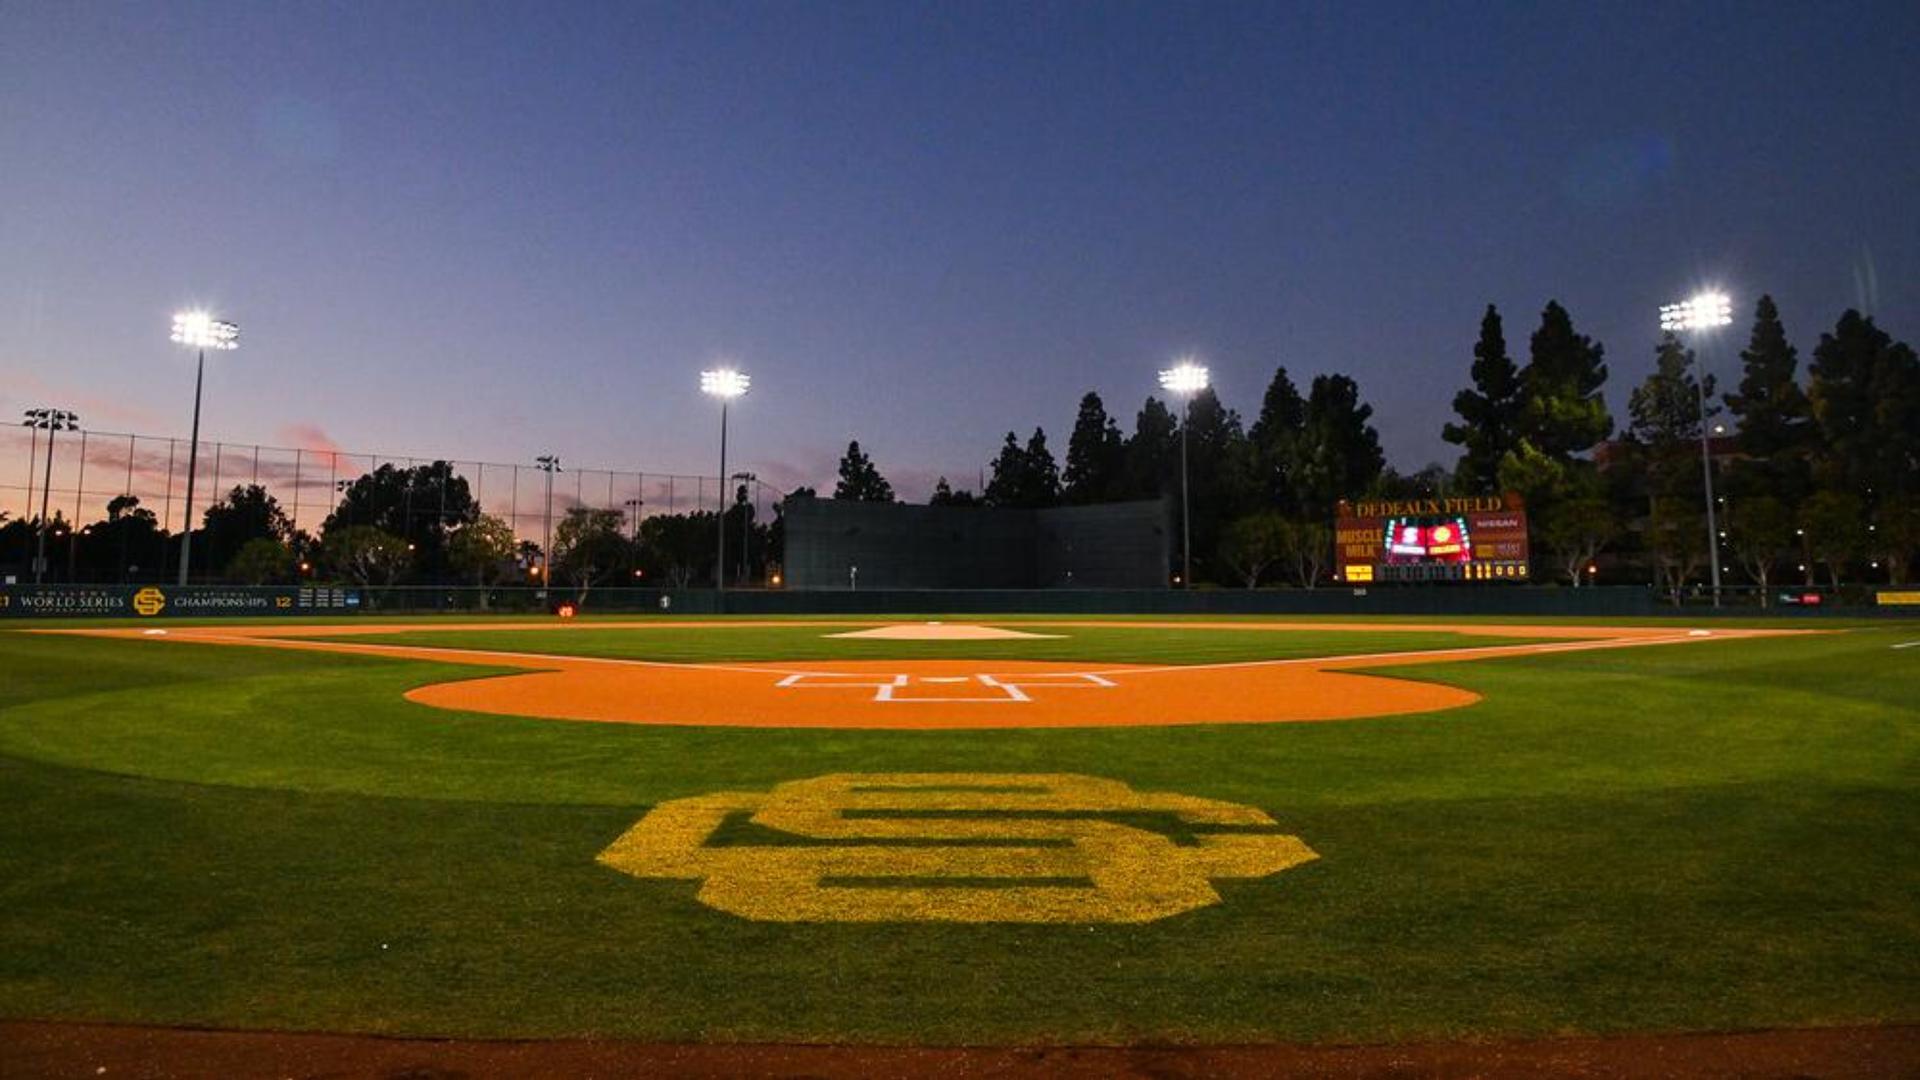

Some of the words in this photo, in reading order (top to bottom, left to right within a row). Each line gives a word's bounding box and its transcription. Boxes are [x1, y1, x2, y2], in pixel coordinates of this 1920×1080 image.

[1357, 500, 1440, 518] DEDEAUX
[1443, 497, 1503, 513] FIELD
[1477, 519, 1518, 528] NISSAN
[1337, 528, 1382, 544] MUSCLE
[1346, 544, 1374, 557] MILK
[21, 596, 76, 608] WORLD
[79, 597, 124, 608] SERIES
[174, 597, 268, 608] CHAMPIONSHIPS
[275, 596, 293, 608] 12
